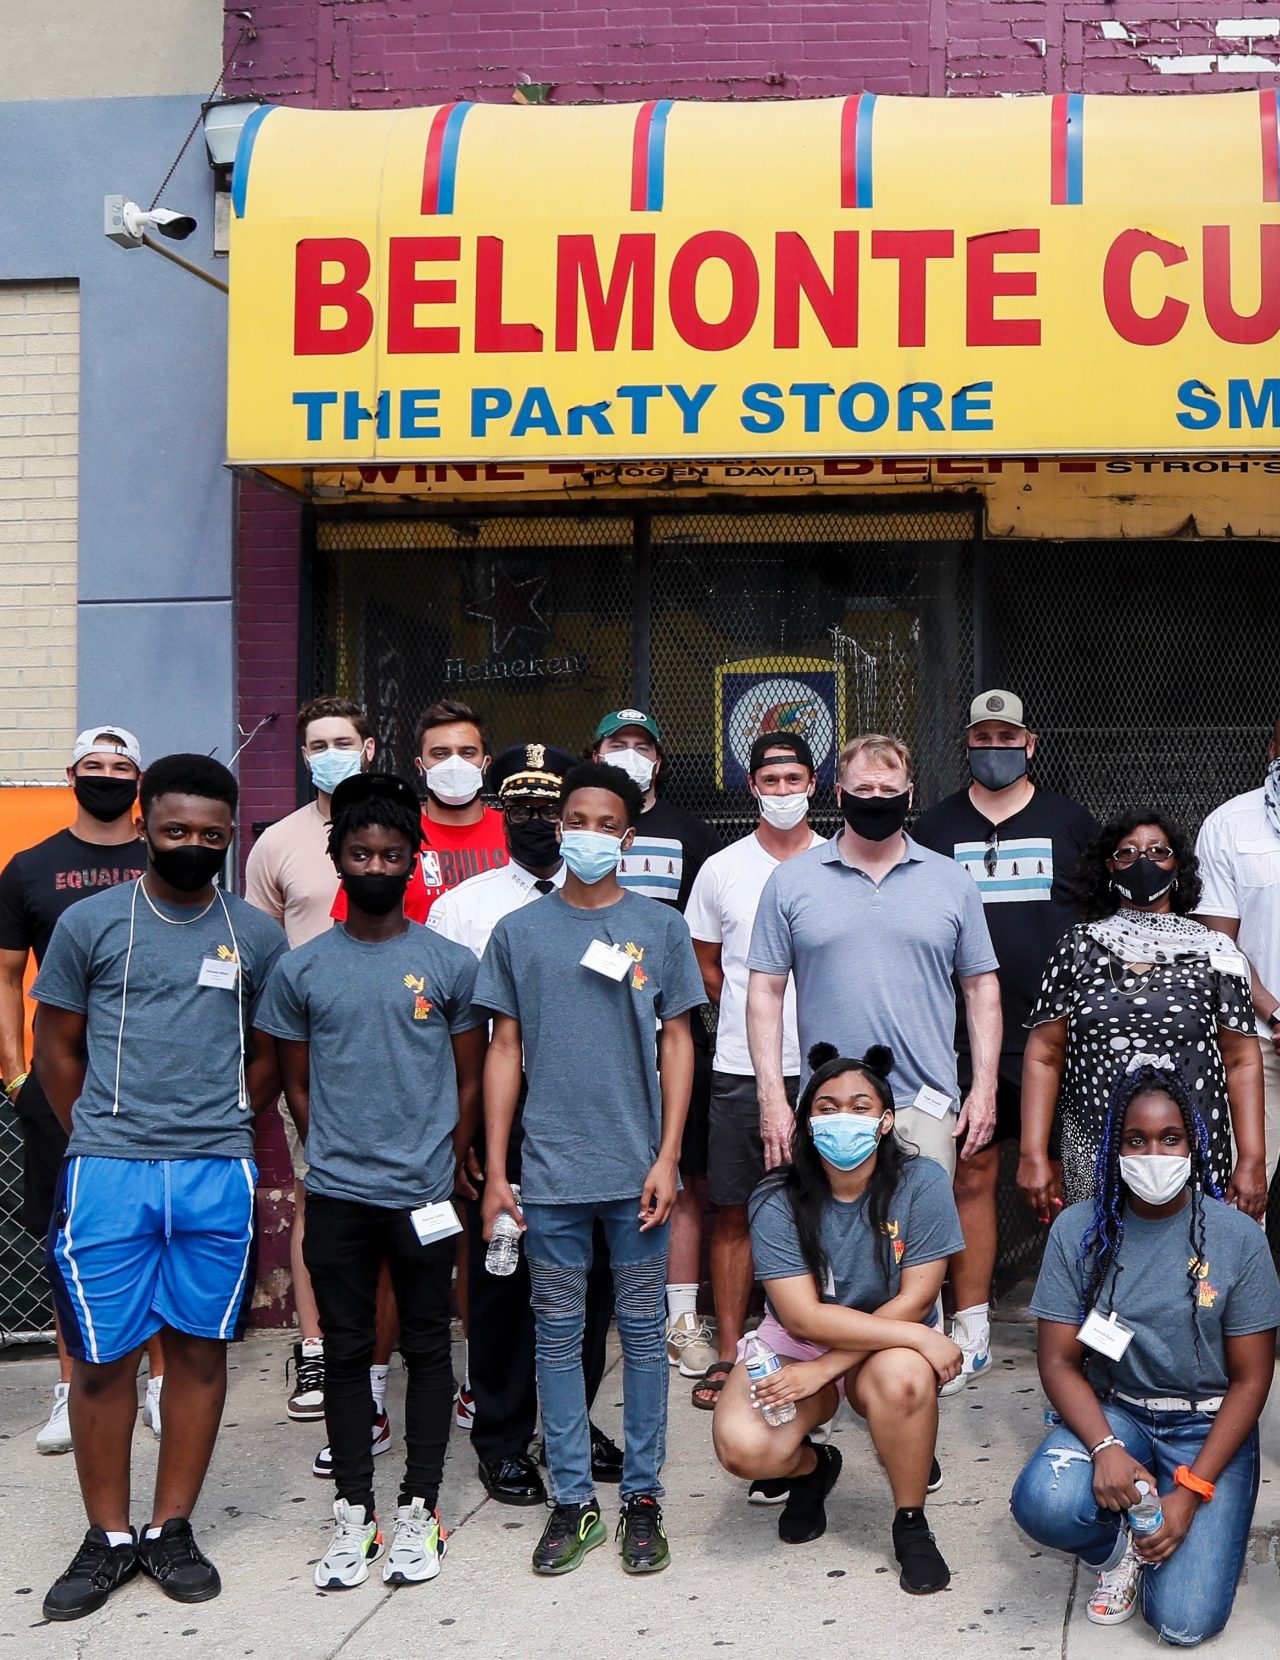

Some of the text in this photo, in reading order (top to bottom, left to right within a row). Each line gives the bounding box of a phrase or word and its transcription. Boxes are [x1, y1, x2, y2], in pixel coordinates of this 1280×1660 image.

[293, 228, 1042, 356] BELMONTE
[292, 389, 441, 441] THE
[471, 383, 717, 437] PARTY
[740, 382, 994, 433] STORE
[596, 466, 814, 477] MOGEN DAVID
[442, 651, 583, 683] Heineken
[56, 867, 143, 890] EQUALIT
